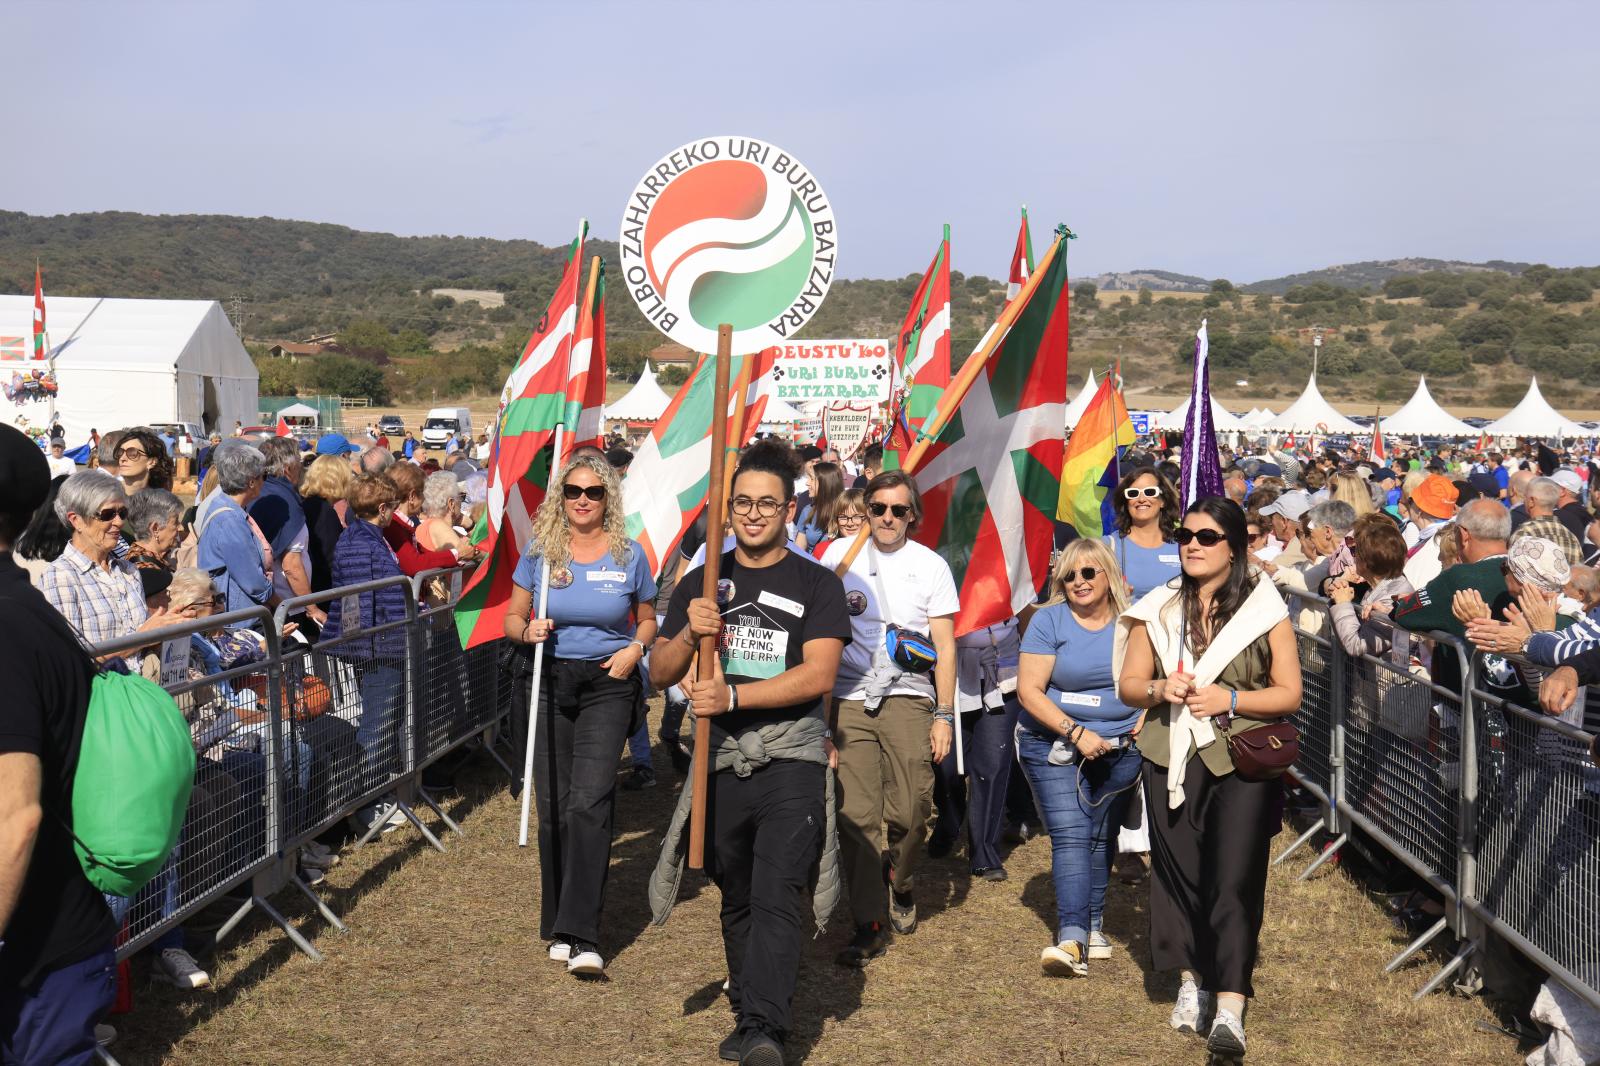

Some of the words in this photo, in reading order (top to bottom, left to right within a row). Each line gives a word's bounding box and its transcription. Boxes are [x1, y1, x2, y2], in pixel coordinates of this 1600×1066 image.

[728, 138, 770, 165] URI
[771, 152, 828, 214] BURU
[623, 140, 720, 259] ZAHARREKO
[768, 219, 835, 338] BATZARRA
[627, 265, 680, 334] BILBO
[824, 366, 869, 380] BURU
[777, 384, 879, 398] BATZARRA
[739, 614, 760, 627] YOU
[723, 625, 744, 636] ARE
[748, 628, 773, 640] NOW
[721, 637, 773, 651] ENTERING
[743, 650, 779, 662] DERRY
